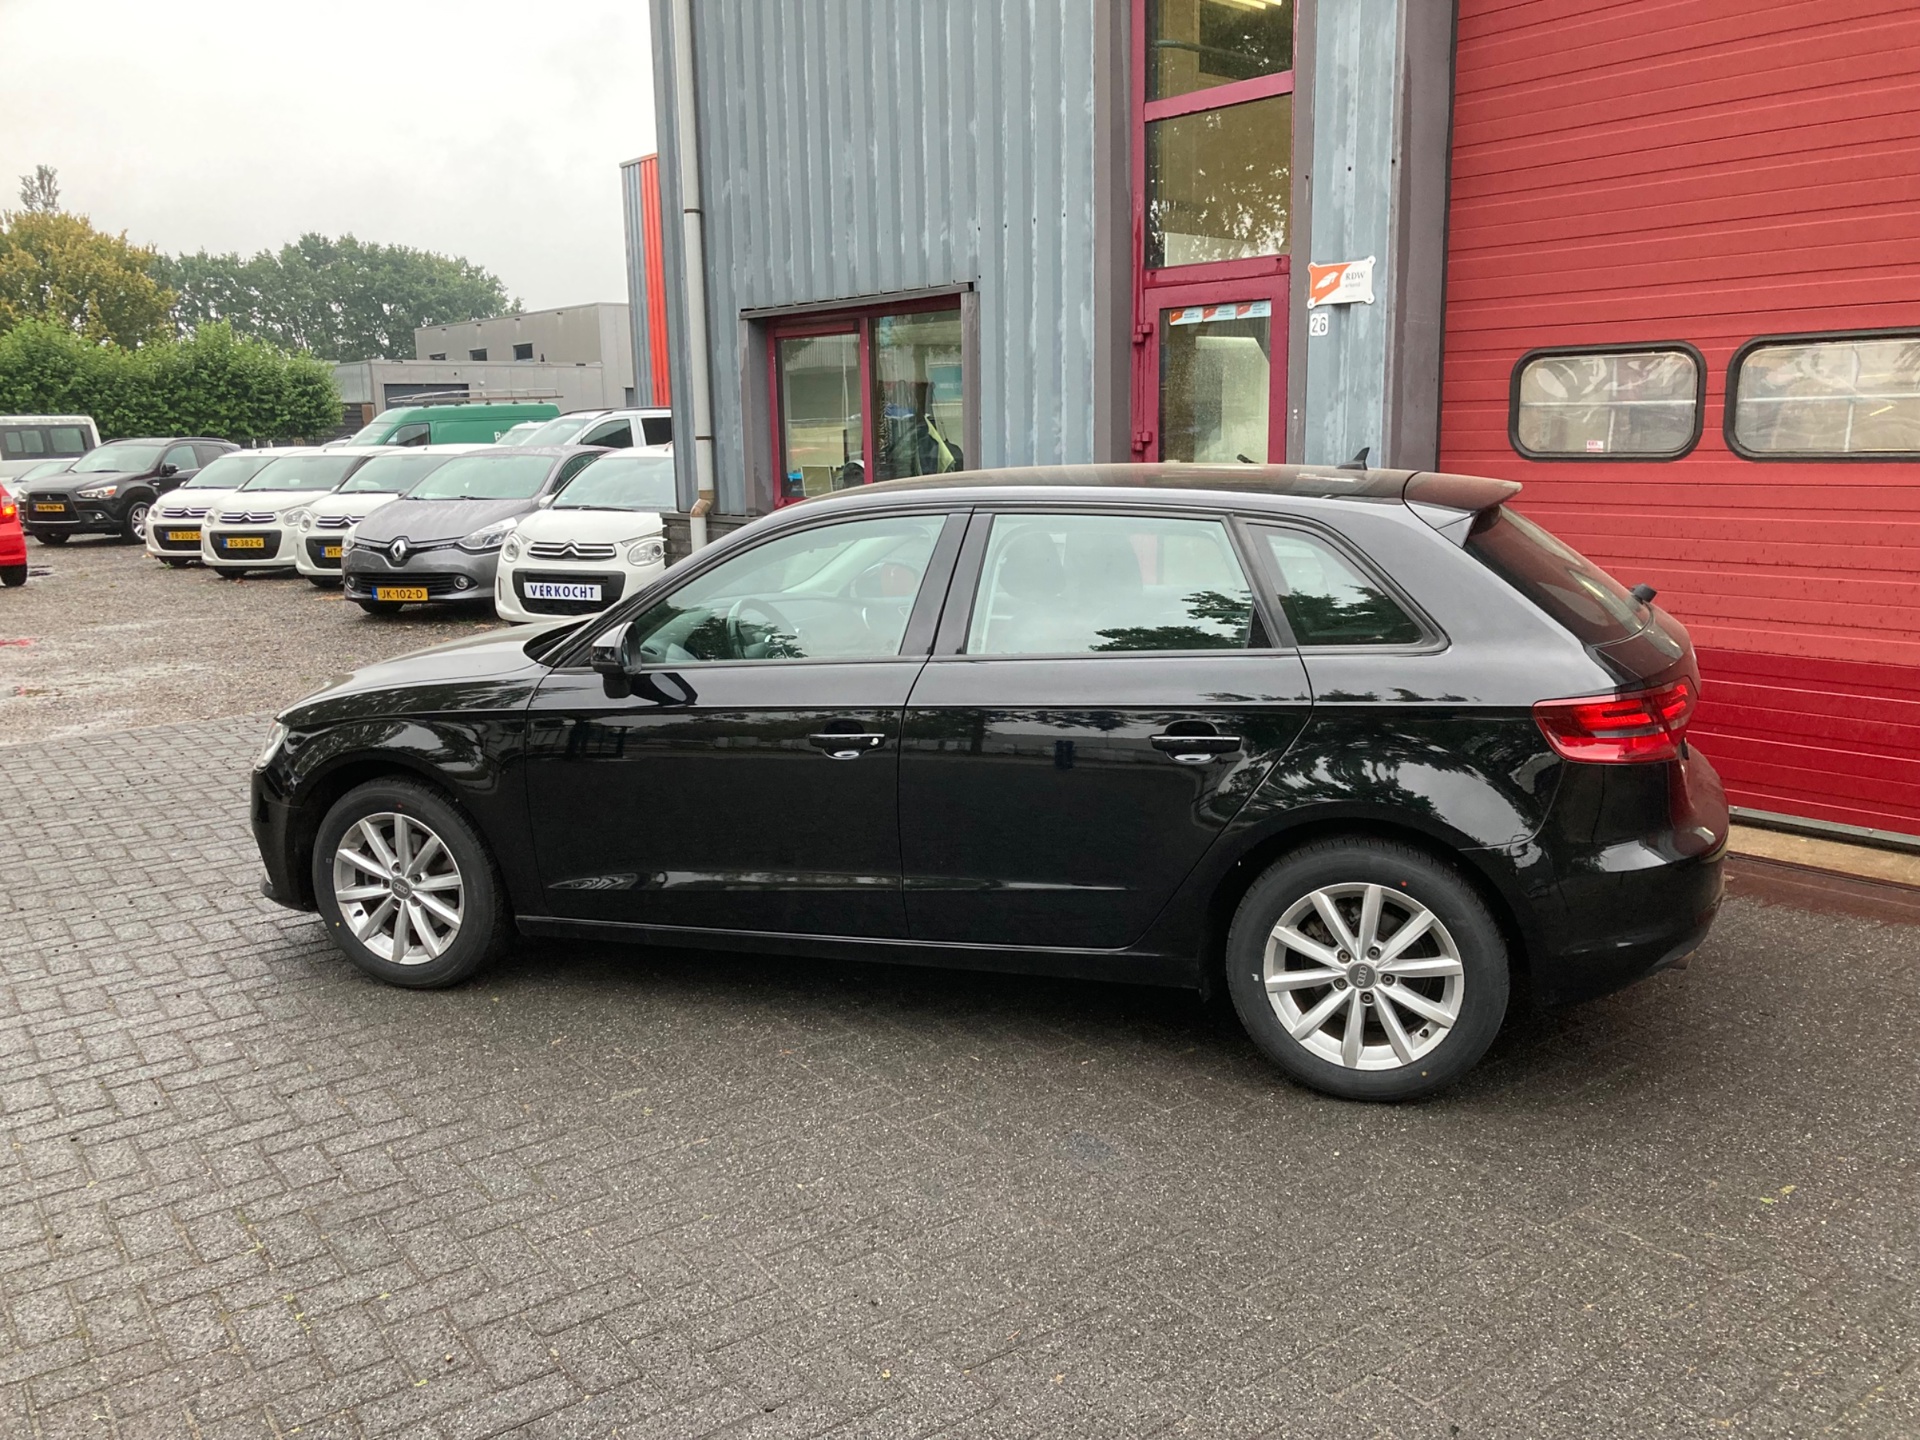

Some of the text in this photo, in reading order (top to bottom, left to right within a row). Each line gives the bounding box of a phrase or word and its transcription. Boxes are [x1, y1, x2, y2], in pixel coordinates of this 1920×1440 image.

[1345, 271, 1366, 280] RDW
[1311, 316, 1327, 333] 26
[229, 539, 262, 547] ZS-382-G
[381, 589, 423, 599] JK-102-D
[530, 584, 595, 599] VERKOCHT
